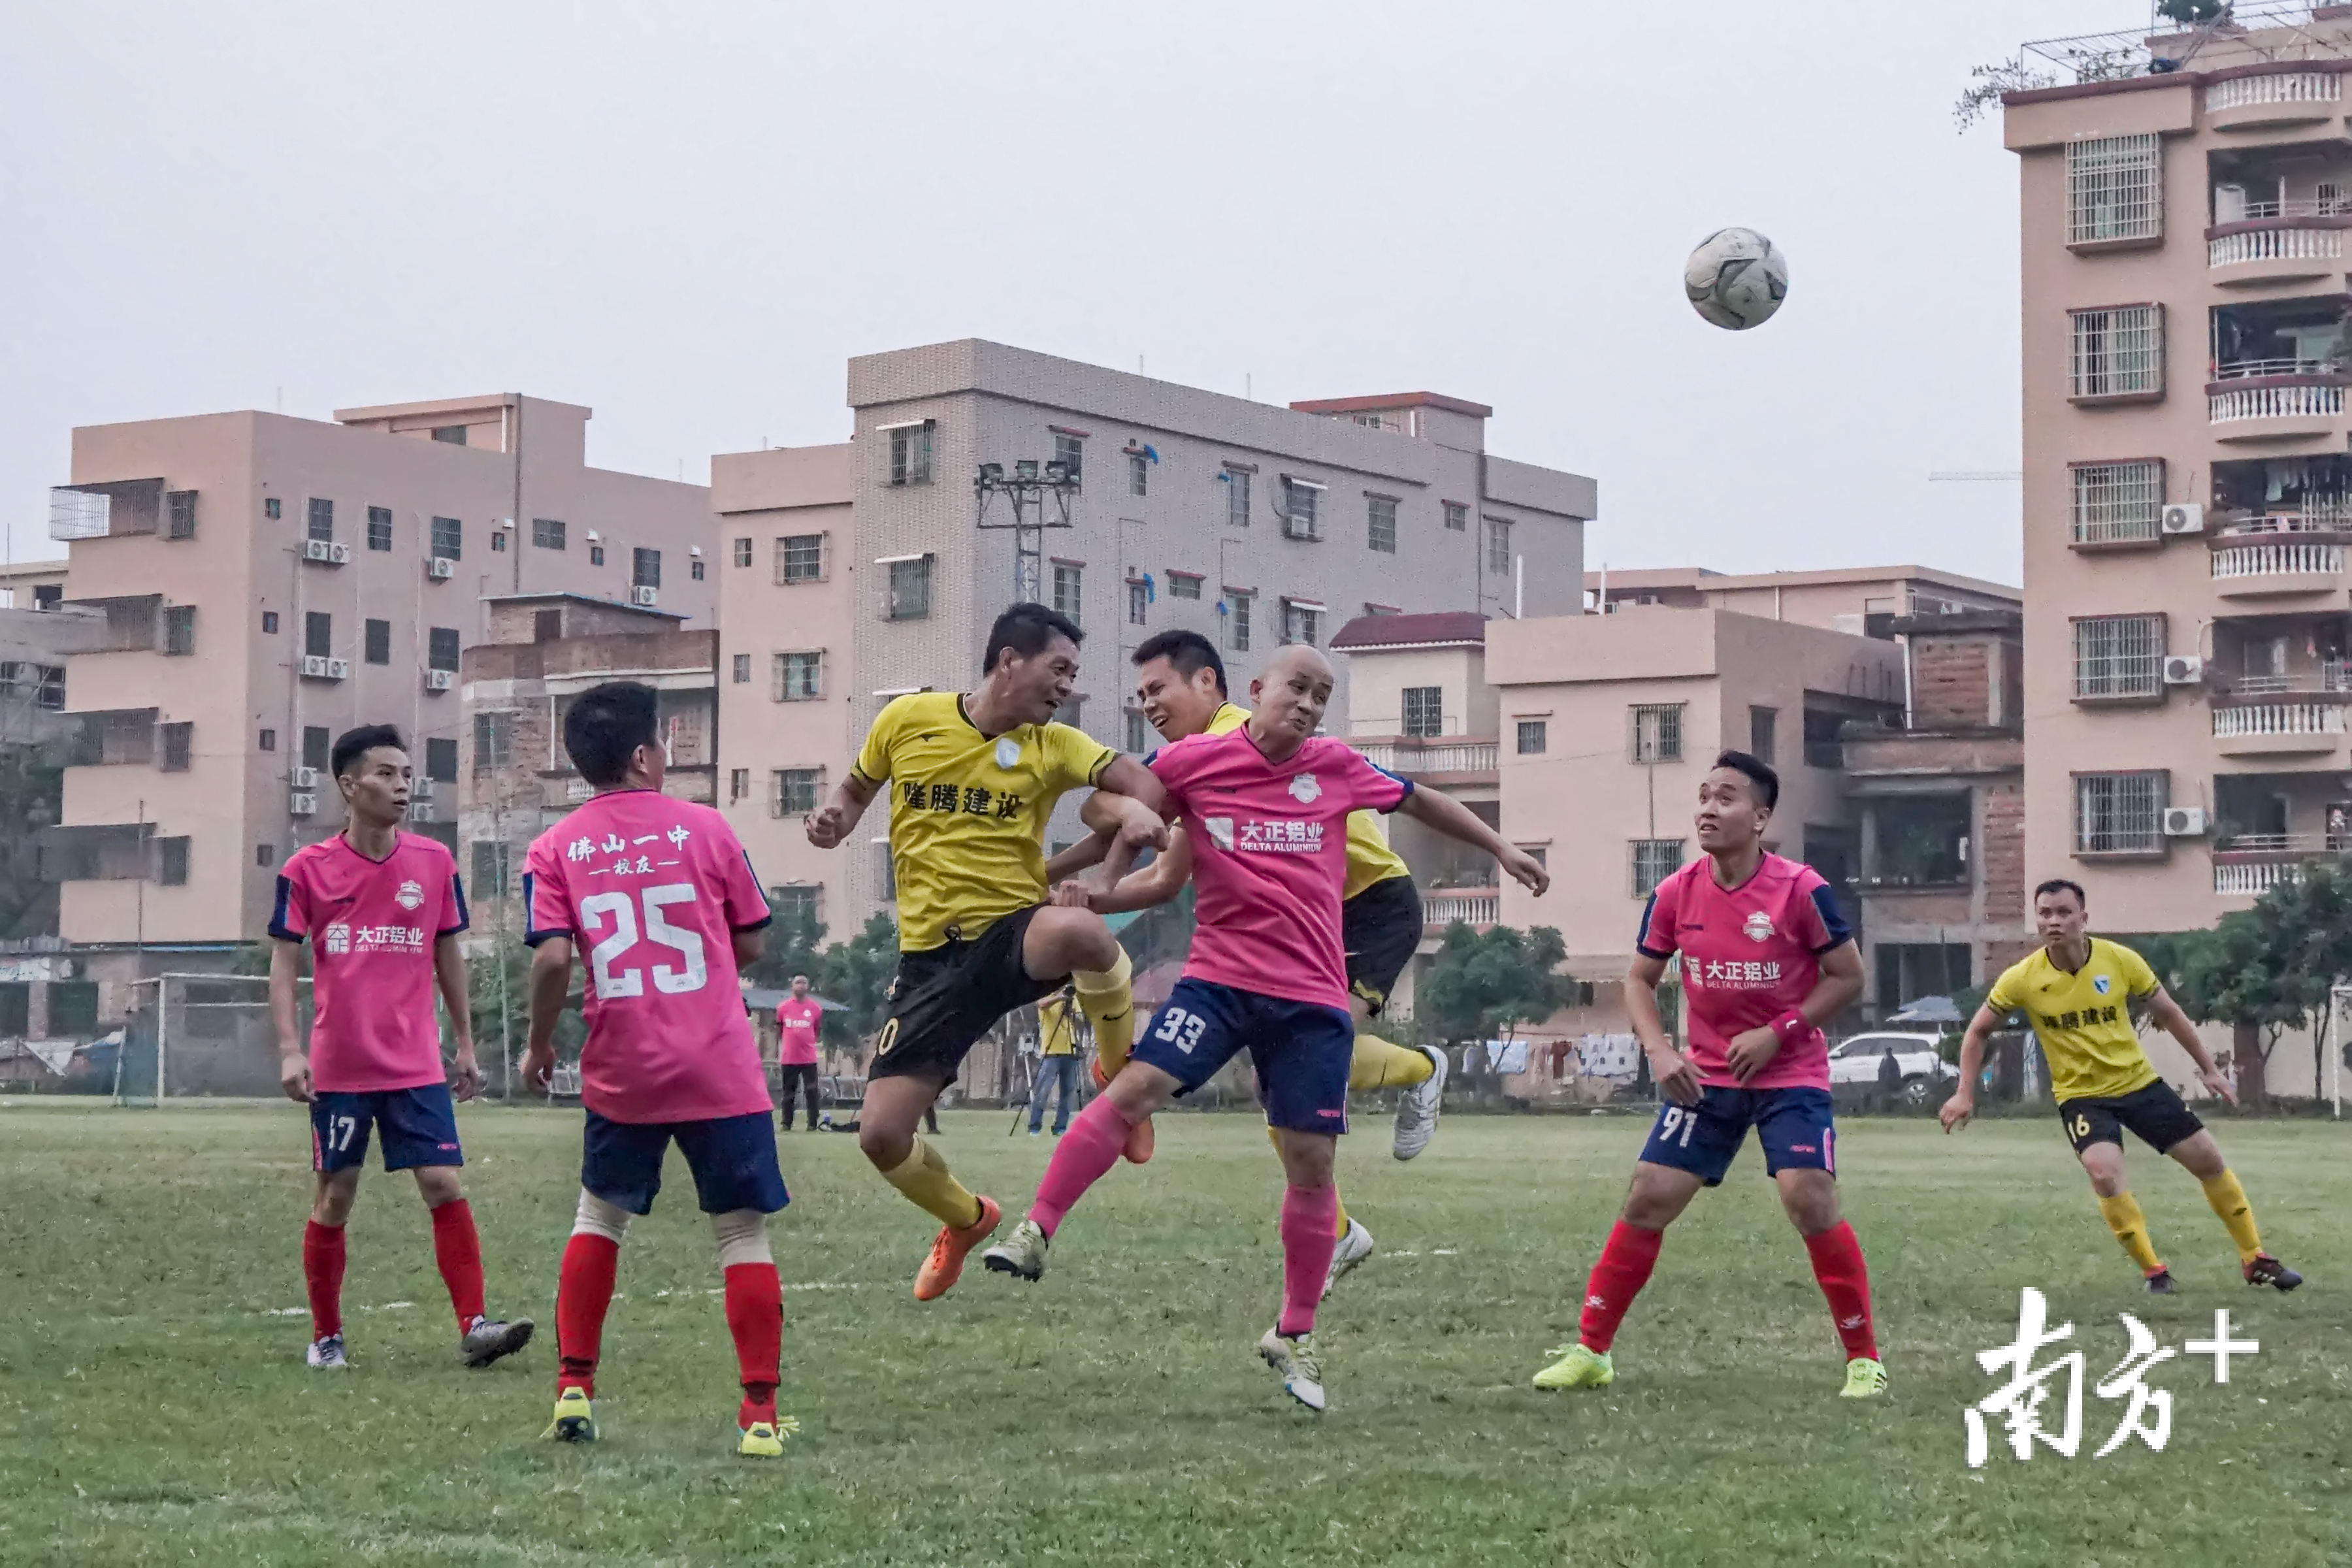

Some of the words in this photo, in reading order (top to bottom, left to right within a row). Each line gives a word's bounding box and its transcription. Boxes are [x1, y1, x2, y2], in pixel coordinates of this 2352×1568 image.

[904, 783, 1022, 819] 隆腾建设
[567, 825, 690, 862] 佛山一中
[1240, 841, 1271, 851] DELTA
[1241, 820, 1324, 842] 大正铝业
[356, 925, 423, 946] 大正铝业
[580, 883, 708, 1000] 25
[1706, 959, 1781, 981] 大正铝业
[1155, 1007, 1206, 1054] 33
[329, 1114, 355, 1151] 17
[1659, 1107, 1698, 1148] 91
[2068, 1114, 2090, 1143] 16
